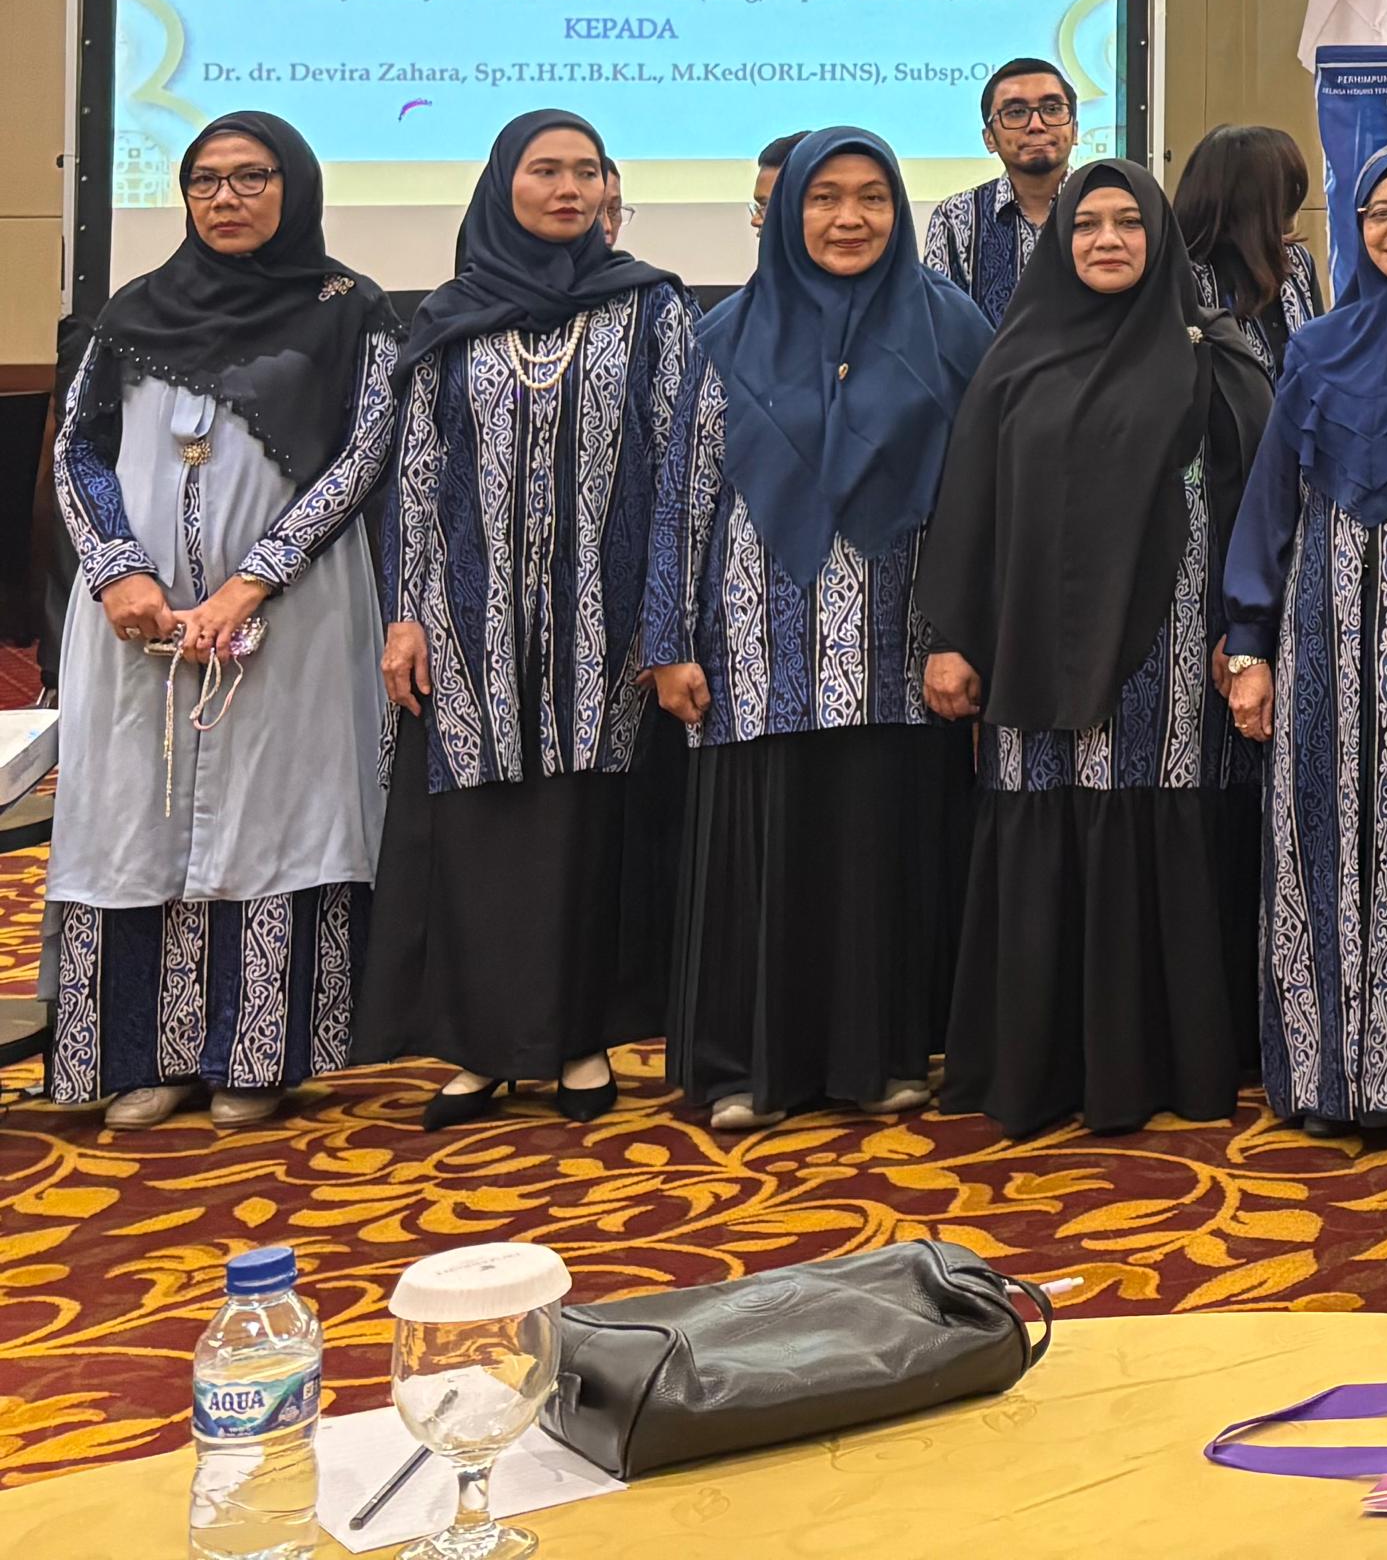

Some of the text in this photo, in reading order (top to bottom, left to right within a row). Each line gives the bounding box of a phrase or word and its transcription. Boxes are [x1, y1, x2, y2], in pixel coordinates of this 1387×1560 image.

[564, 17, 679, 40] KEPADA
[203, 62, 241, 82] Dr.
[249, 63, 281, 82] dr.
[289, 63, 371, 82] Devira
[378, 62, 467, 85] Zahara,
[208, 1389, 266, 1415] AQUA
